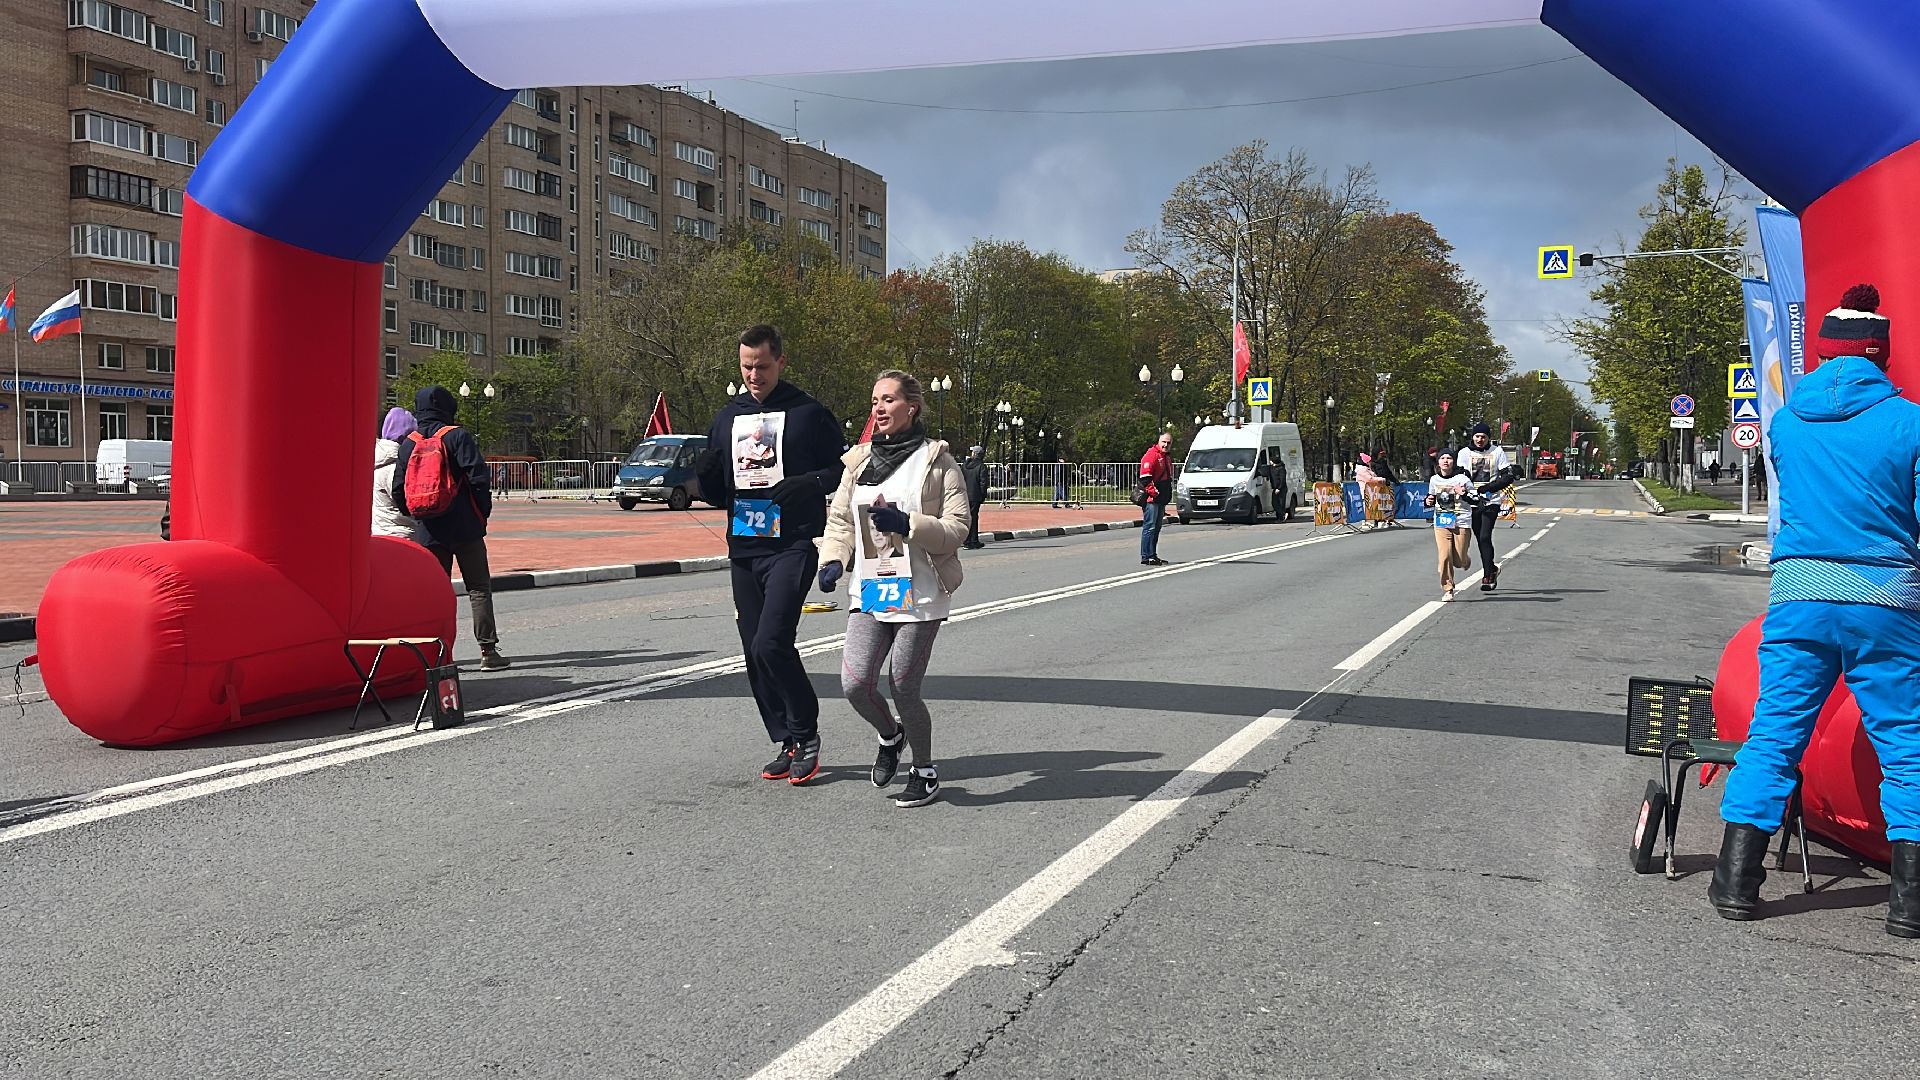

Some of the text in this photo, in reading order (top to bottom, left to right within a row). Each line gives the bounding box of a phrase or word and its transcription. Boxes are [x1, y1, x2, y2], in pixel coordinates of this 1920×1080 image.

[1739, 429, 1755, 441] 20
[745, 510, 766, 529] 72
[877, 583, 901, 602] 73
